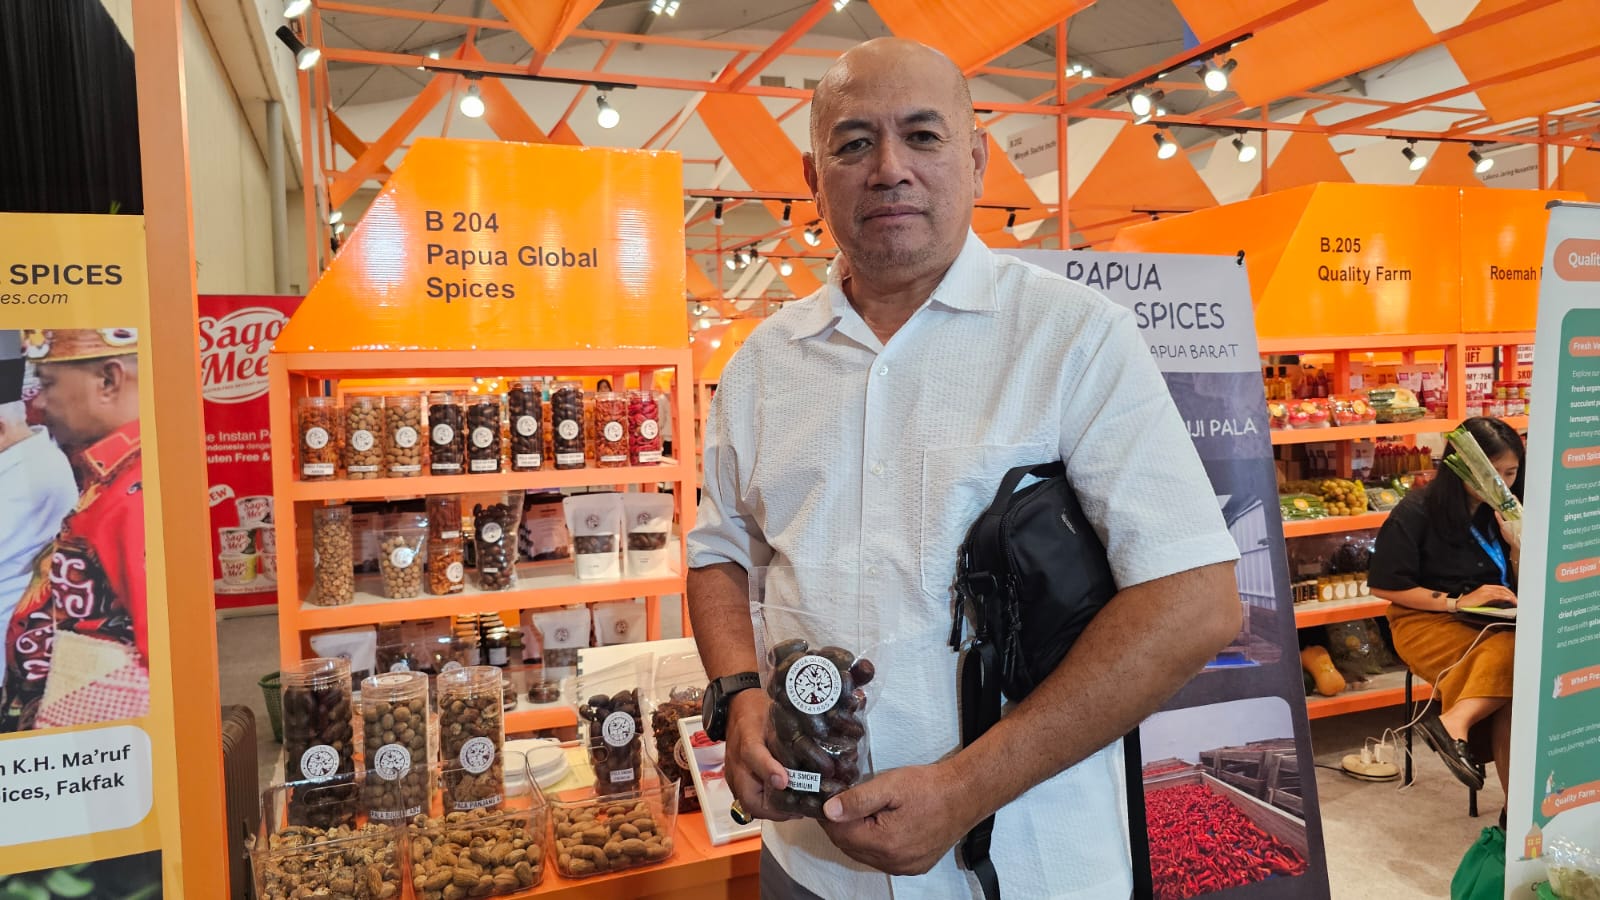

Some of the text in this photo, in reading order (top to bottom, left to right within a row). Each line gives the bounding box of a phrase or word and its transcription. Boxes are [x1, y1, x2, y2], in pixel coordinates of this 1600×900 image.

[425, 210, 499, 233] B 204
[1320, 237, 1361, 253] B.205
[427, 243, 598, 270] Papua Global
[10, 264, 123, 285] SPICES
[1066, 261, 1162, 291] PAPUA
[1318, 265, 1412, 285] Quality Farm
[1490, 265, 1536, 281] Roemah
[426, 276, 515, 303] Spices
[1134, 301, 1225, 329] SPICES
[199, 319, 284, 355] Sago
[1150, 343, 1239, 359] APUA BARAT
[1465, 351, 1480, 362] IFT
[202, 351, 269, 386] Mee
[219, 431, 256, 442] Instan
[1186, 417, 1258, 437] IJI PALA
[207, 454, 233, 463] uten
[209, 487, 227, 501] EW
[13, 756, 56, 775] K.H.
[62, 745, 131, 768] Ma’ruf
[57, 772, 125, 796] Fakfak
[790, 781, 813, 790] REMIUM
[1554, 789, 1596, 807] Quality Farm
